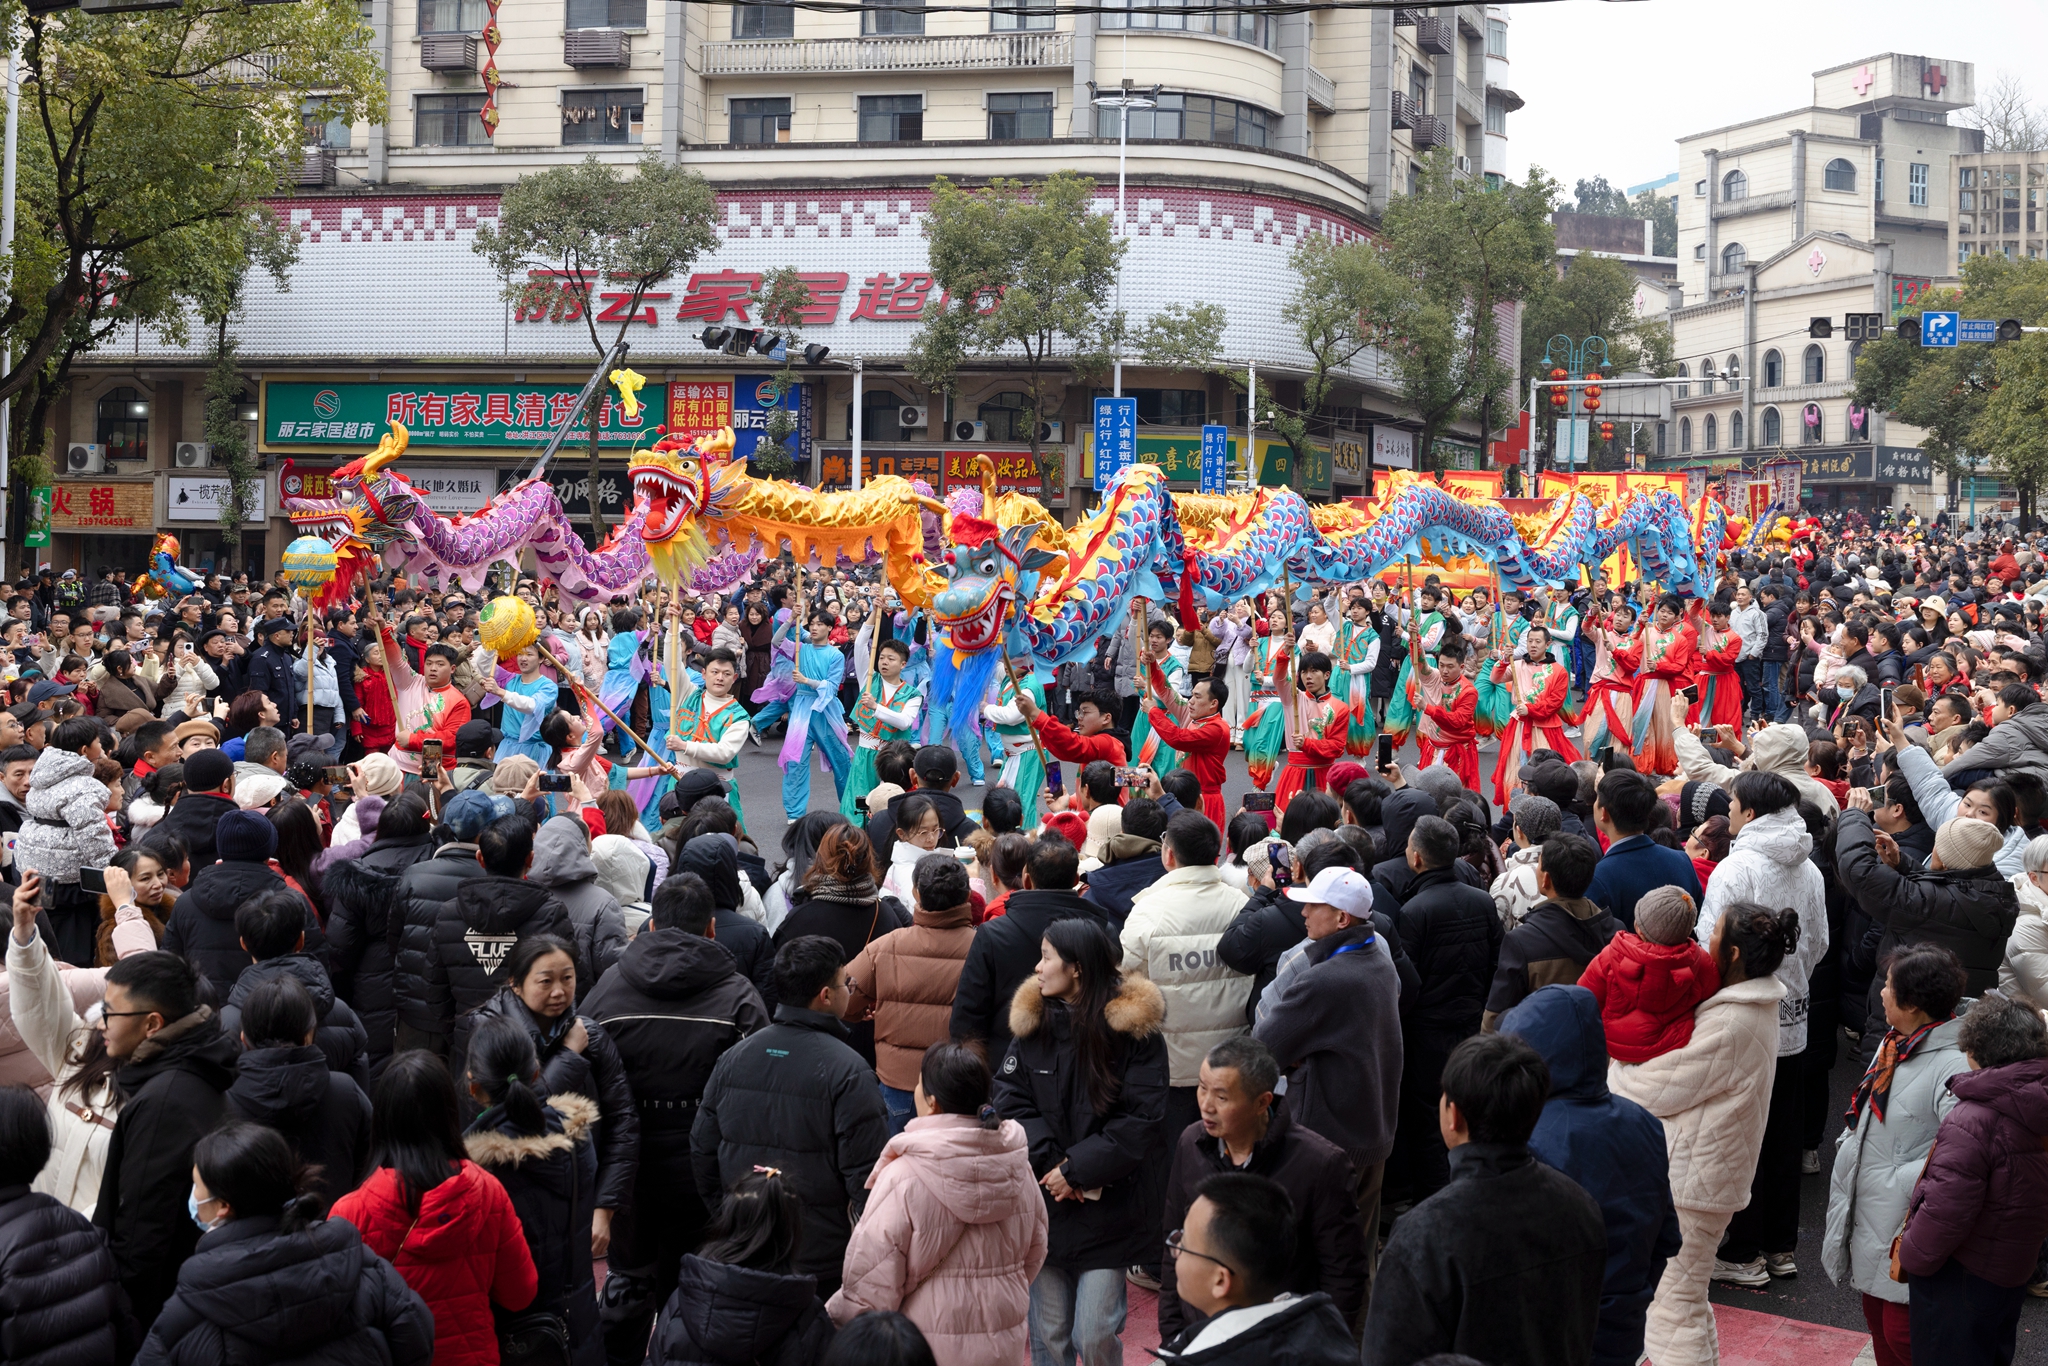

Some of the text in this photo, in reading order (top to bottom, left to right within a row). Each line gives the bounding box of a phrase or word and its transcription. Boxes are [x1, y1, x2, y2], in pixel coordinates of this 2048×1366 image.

[673, 385, 729, 399] 运输公司
[673, 400, 728, 413] 所有门面
[673, 414, 728, 428] 低价出售
[277, 421, 375, 439] 丽云家居超市
[901, 457, 939, 471] 老字号
[52, 487, 115, 516] 火锅
[467, 941, 515, 958] ALIVE
